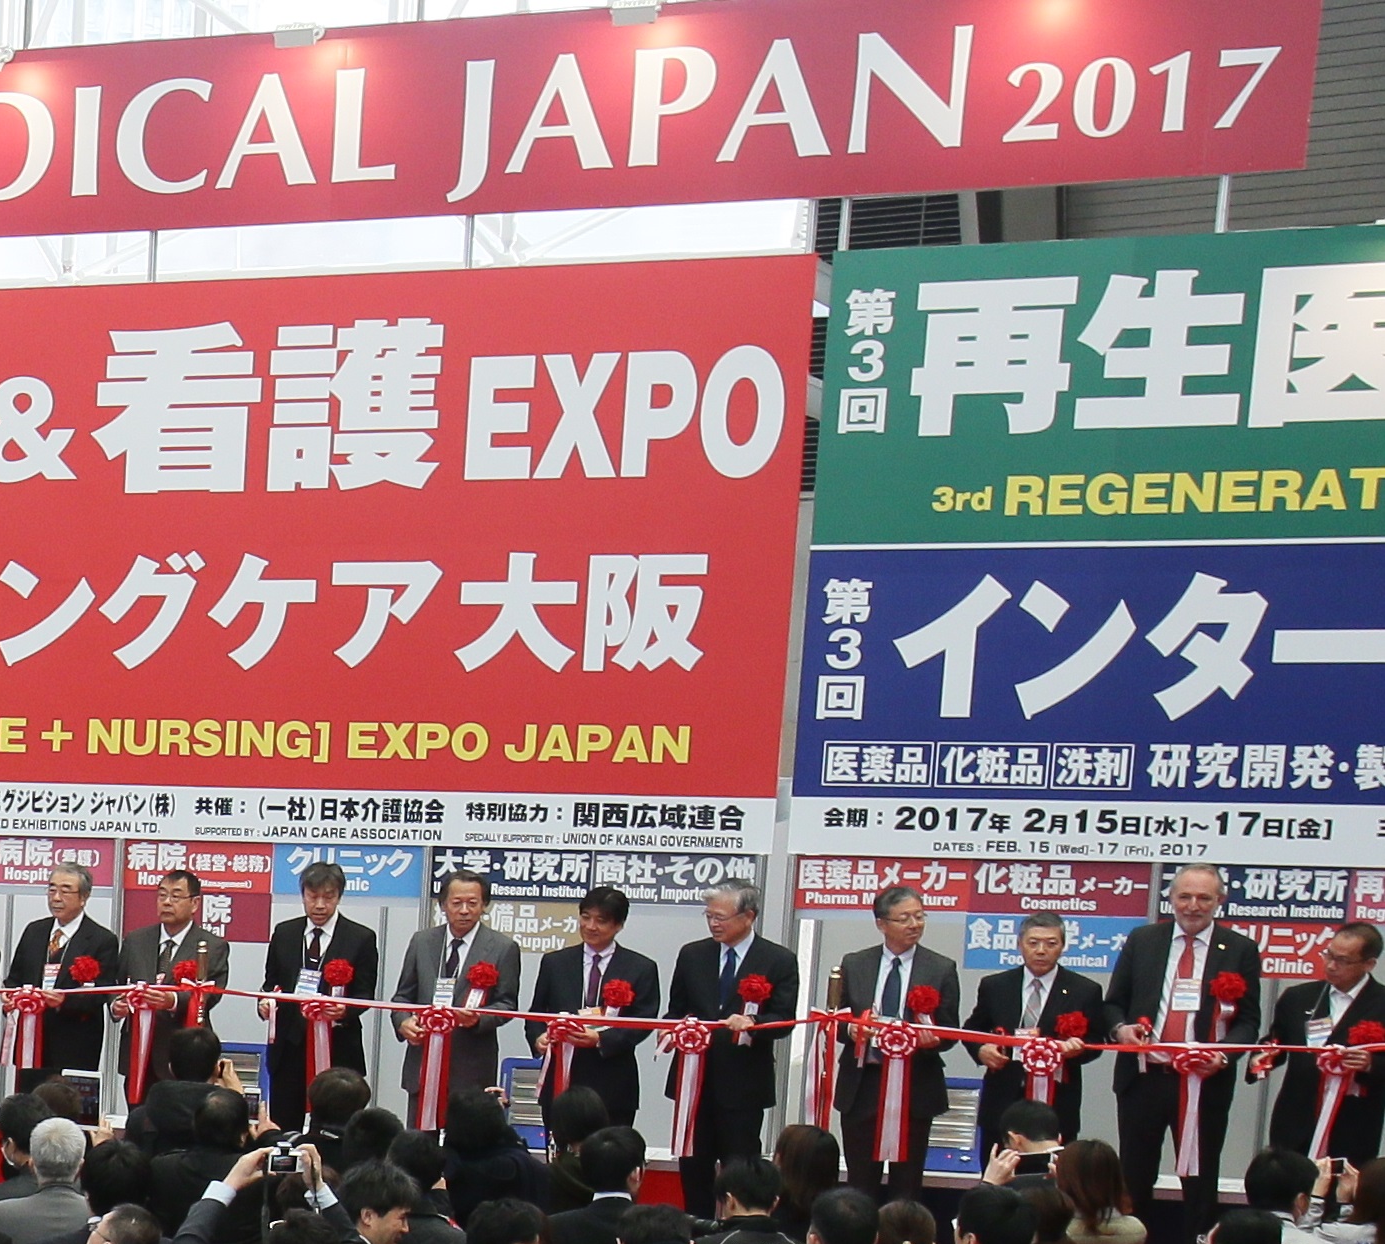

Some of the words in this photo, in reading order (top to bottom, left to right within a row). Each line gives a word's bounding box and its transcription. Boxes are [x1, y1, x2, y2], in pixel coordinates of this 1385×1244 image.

[448, 24, 975, 203] JAPAN
[1002, 45, 1281, 144] 2017
[838, 289, 895, 433] 第3回
[910, 262, 1385, 437] 再生医
[465, 344, 785, 483] EXPO
[932, 486, 992, 512] 3rd
[1004, 468, 1385, 516] REGENERAT
[816, 578, 873, 721] 第3回
[41, 721, 74, 752] +
[87, 719, 330, 763] NURSING]
[347, 722, 488, 762] EXPO
[503, 723, 690, 765] JAPAN
[826, 747, 928, 785] 医薬品
[942, 748, 1045, 786] 化粧品
[1056, 748, 1129, 787] 洗剤
[12, 819, 87, 831] EXHIBITIONS
[90, 821, 131, 833] JAPAN
[135, 822, 160, 834] LTD.
[573, 803, 745, 832] 関西広域連合
[263, 826, 307, 839] JAPAN
[311, 827, 347, 840] CARE
[351, 828, 442, 842] ASSOCIATION
[563, 833, 592, 845] UNION
[595, 834, 613, 845] OF
[616, 834, 658, 846] KANSAI
[660, 835, 744, 849] GOVERNMENTS
[985, 841, 1021, 853] FEB.
[1029, 841, 1049, 853] 15
[1160, 843, 1208, 857] 2017
[491, 884, 539, 898] Research
[542, 884, 587, 899] Institute
[805, 892, 857, 905] Pharma
[1021, 897, 1097, 912] Cosmetics
[1228, 903, 1287, 918] Research
[1290, 905, 1344, 919] Institute
[1262, 957, 1314, 975] Clinic
